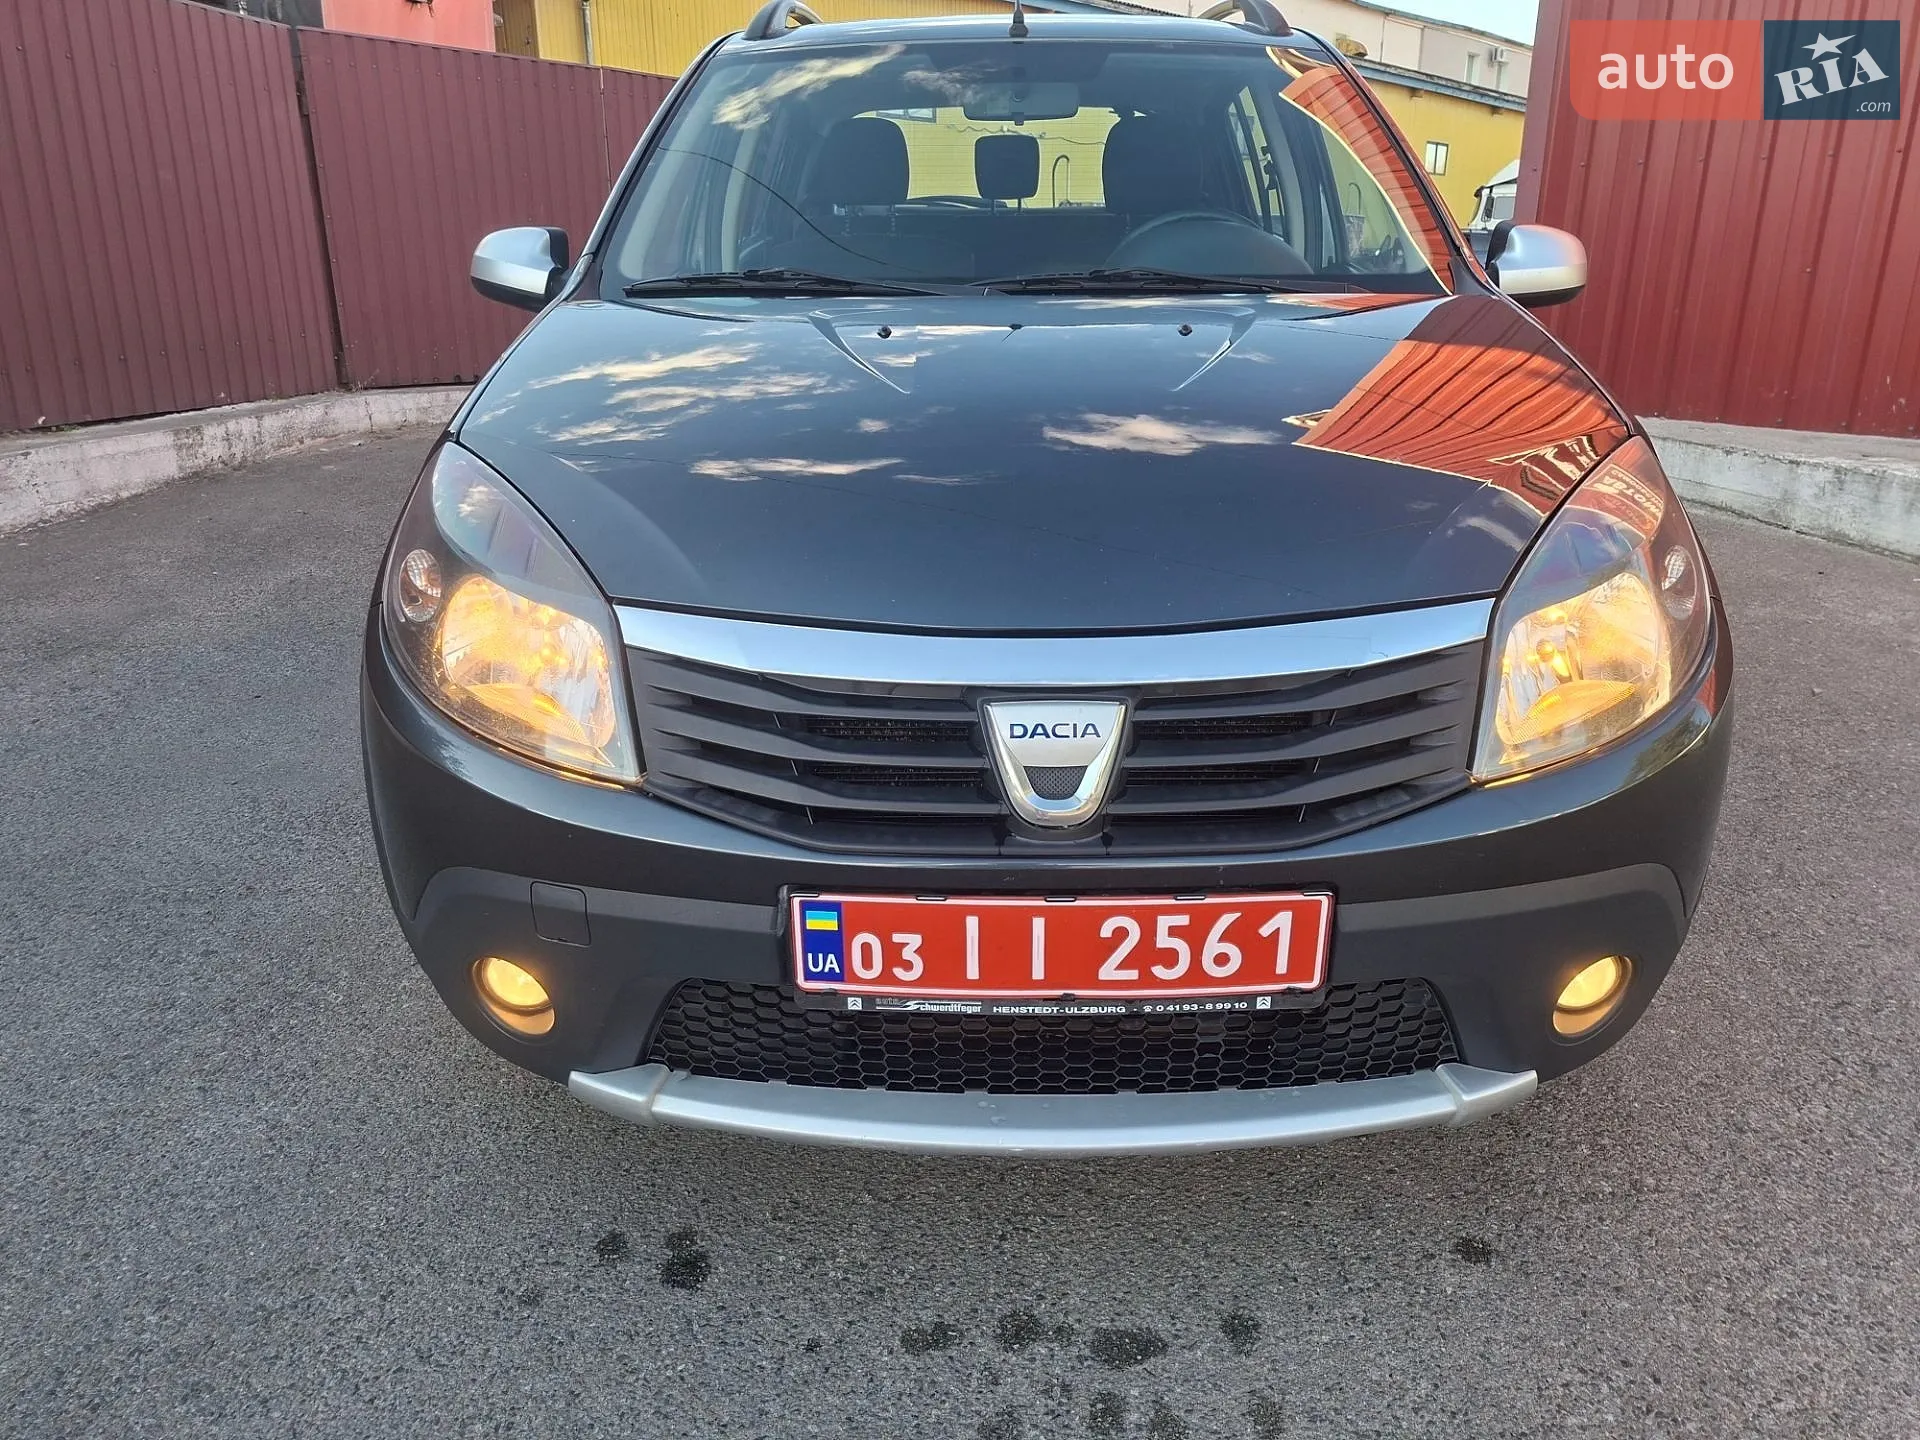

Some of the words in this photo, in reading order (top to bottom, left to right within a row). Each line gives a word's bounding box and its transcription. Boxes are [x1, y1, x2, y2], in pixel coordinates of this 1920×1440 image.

[1009, 723, 1101, 739] DACIA
[851, 932, 924, 981] 03
[1098, 911, 1293, 980] 2561
[807, 953, 840, 973] UA
[993, 1006, 1126, 1014] HENSTEDT-ULZBURG
